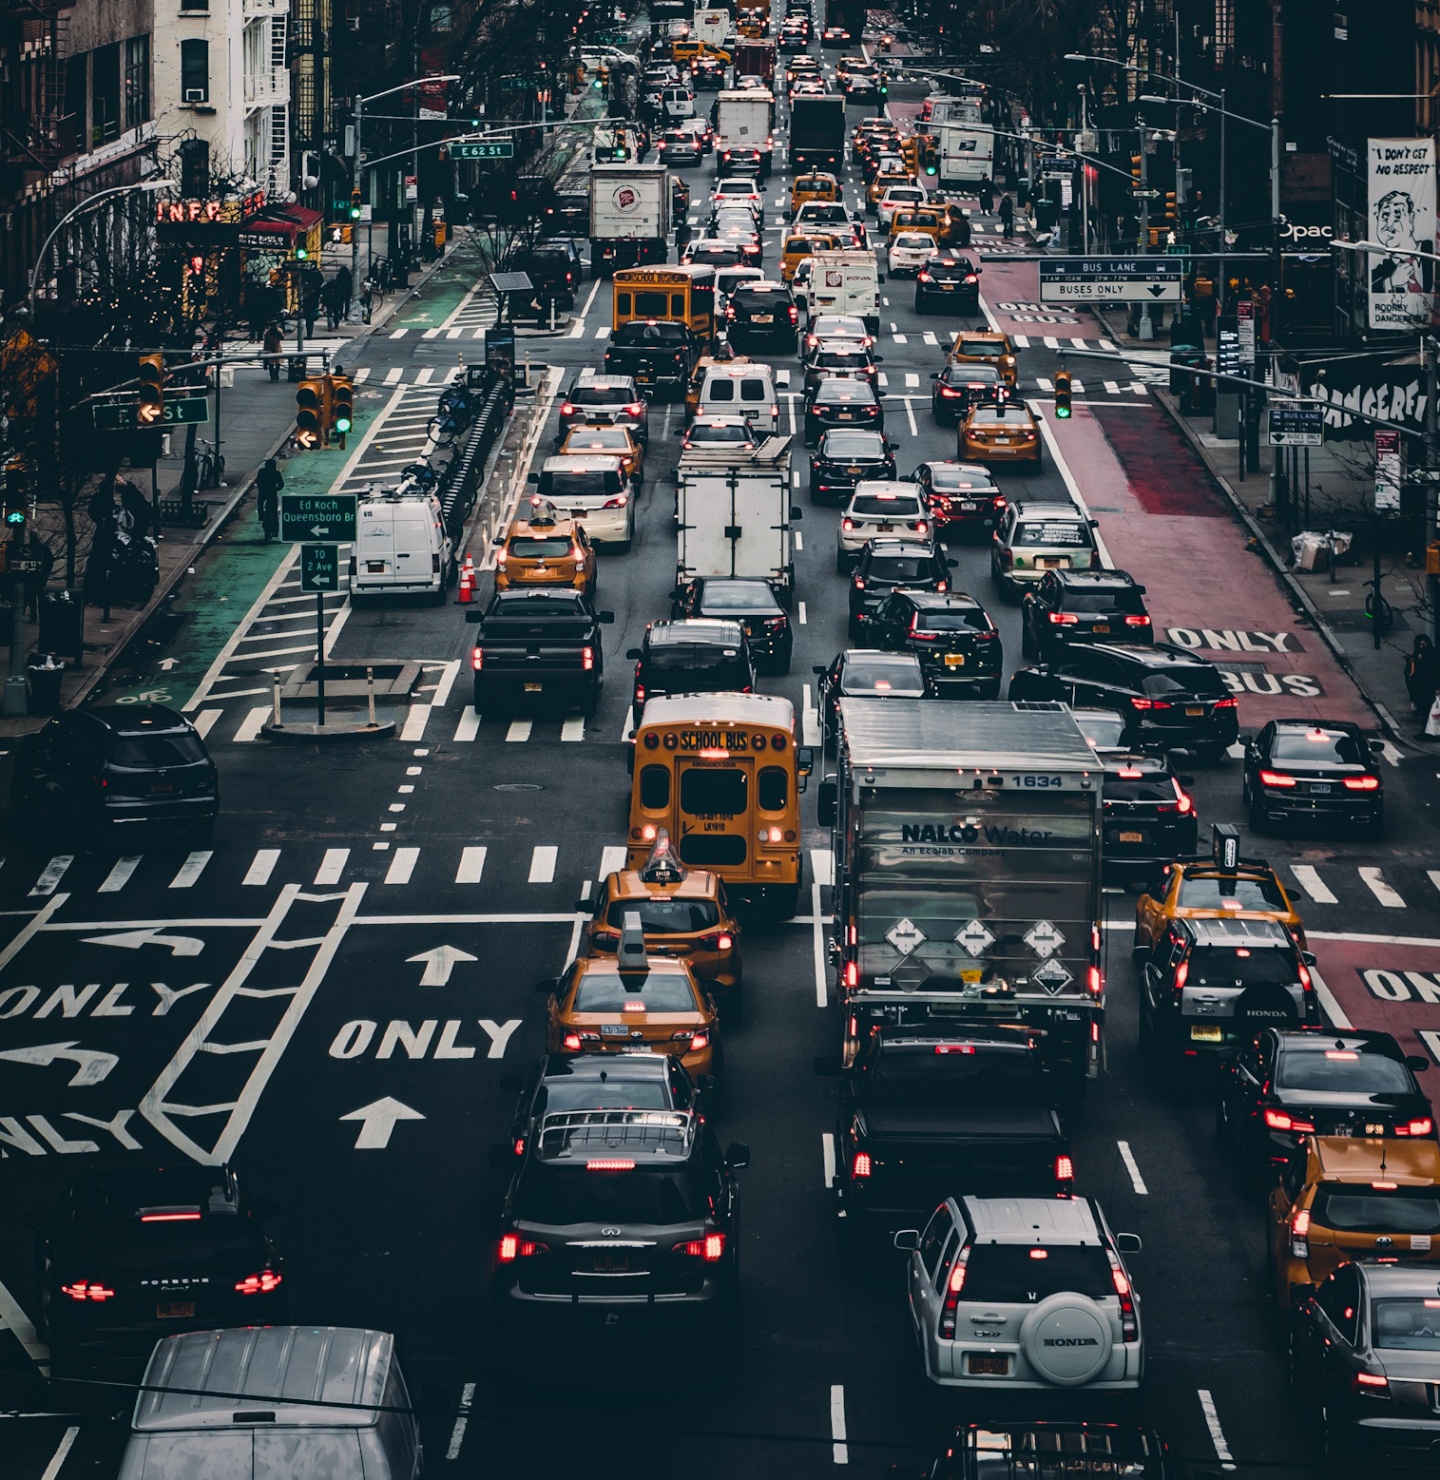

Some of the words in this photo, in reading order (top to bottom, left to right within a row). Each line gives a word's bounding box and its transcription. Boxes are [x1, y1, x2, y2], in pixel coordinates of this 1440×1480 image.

[461, 147, 469, 156] E
[471, 146, 486, 155] 62
[489, 146, 502, 155] St
[1385, 146, 1411, 161] DON'T
[1412, 148, 1428, 160] GET
[1376, 164, 1391, 176] NO
[1083, 263, 1102, 272] BUS
[1110, 263, 1137, 272] LANE
[1060, 285, 1092, 295] BUSES
[1097, 285, 1124, 295] ONLY
[999, 302, 1077, 313] ONLY
[1375, 303, 1408, 312] RODNEY
[1012, 314, 1079, 325] BUS
[163, 406, 183, 420] St
[300, 501, 311, 510] Ed
[315, 501, 338, 510] Koch
[283, 512, 341, 522] Queensboro
[344, 512, 354, 522] Br
[314, 550, 326, 559] TO
[307, 562, 313, 571] 2
[316, 562, 332, 571] Ave
[1167, 627, 1292, 653] ONLY
[1219, 671, 1321, 697] BUS
[681, 731, 724, 750] SCHOOL
[726, 732, 748, 751] BUS
[1012, 776, 1063, 788] 1634
[902, 824, 979, 844] NALCO
[985, 825, 1053, 845] Water
[902, 846, 917, 855] An
[919, 847, 954, 856] Ecolab
[958, 848, 1006, 858] Company
[1039, 972, 1067, 981] CORROSIVE
[0, 984, 212, 1018] ONLY
[1247, 1010, 1288, 1018] HONDA
[329, 1021, 523, 1059] ONLY
